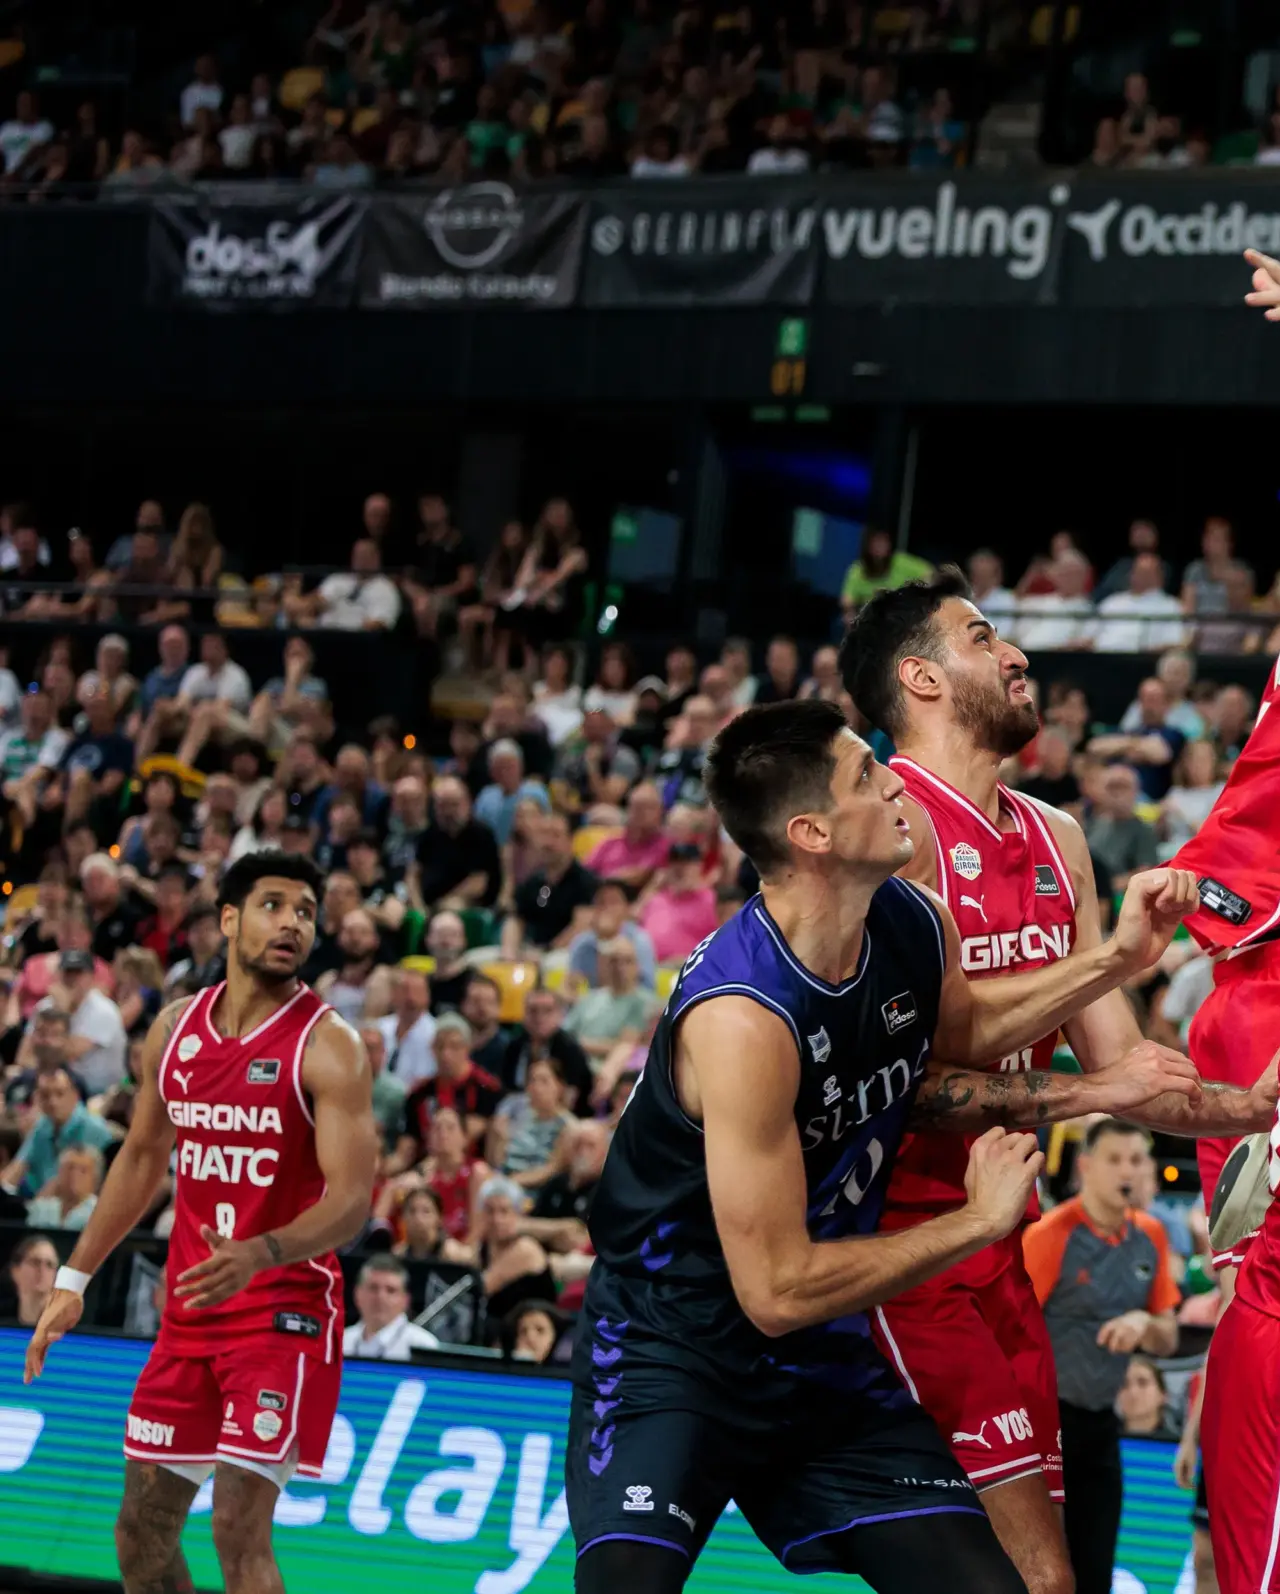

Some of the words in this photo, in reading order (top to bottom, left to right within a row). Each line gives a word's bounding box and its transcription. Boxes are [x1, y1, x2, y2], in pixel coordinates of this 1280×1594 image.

[823, 180, 1054, 280] vueling
[954, 862, 981, 871] GIRONA
[1035, 883, 1057, 891] ndesa
[167, 1100, 284, 1134] GIRONA
[180, 1139, 280, 1187] FIATC
